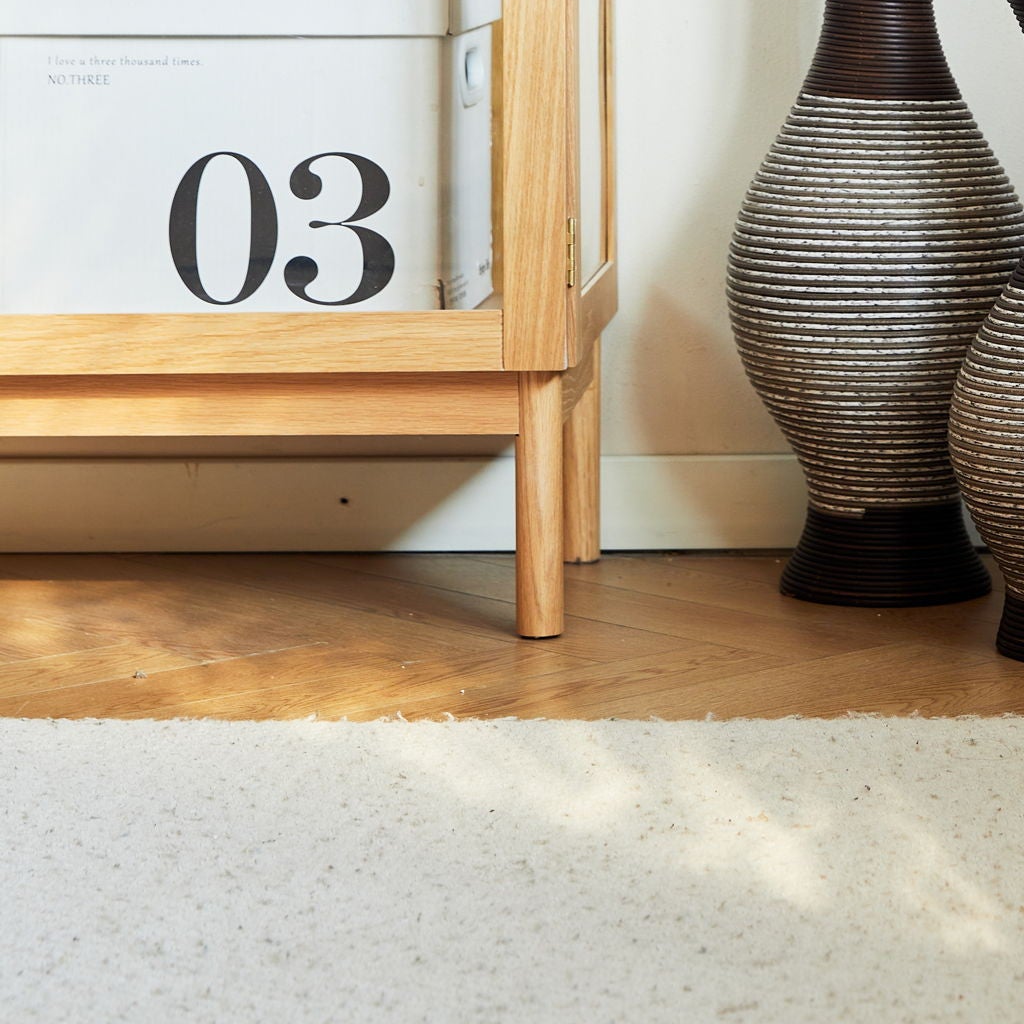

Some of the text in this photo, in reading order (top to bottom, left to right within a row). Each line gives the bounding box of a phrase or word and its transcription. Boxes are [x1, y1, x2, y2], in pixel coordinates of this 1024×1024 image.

[55, 55, 76, 66] love
[79, 58, 86, 66] u
[90, 55, 117, 66] three
[120, 55, 169, 66] thousand
[169, 152, 396, 306] 03
